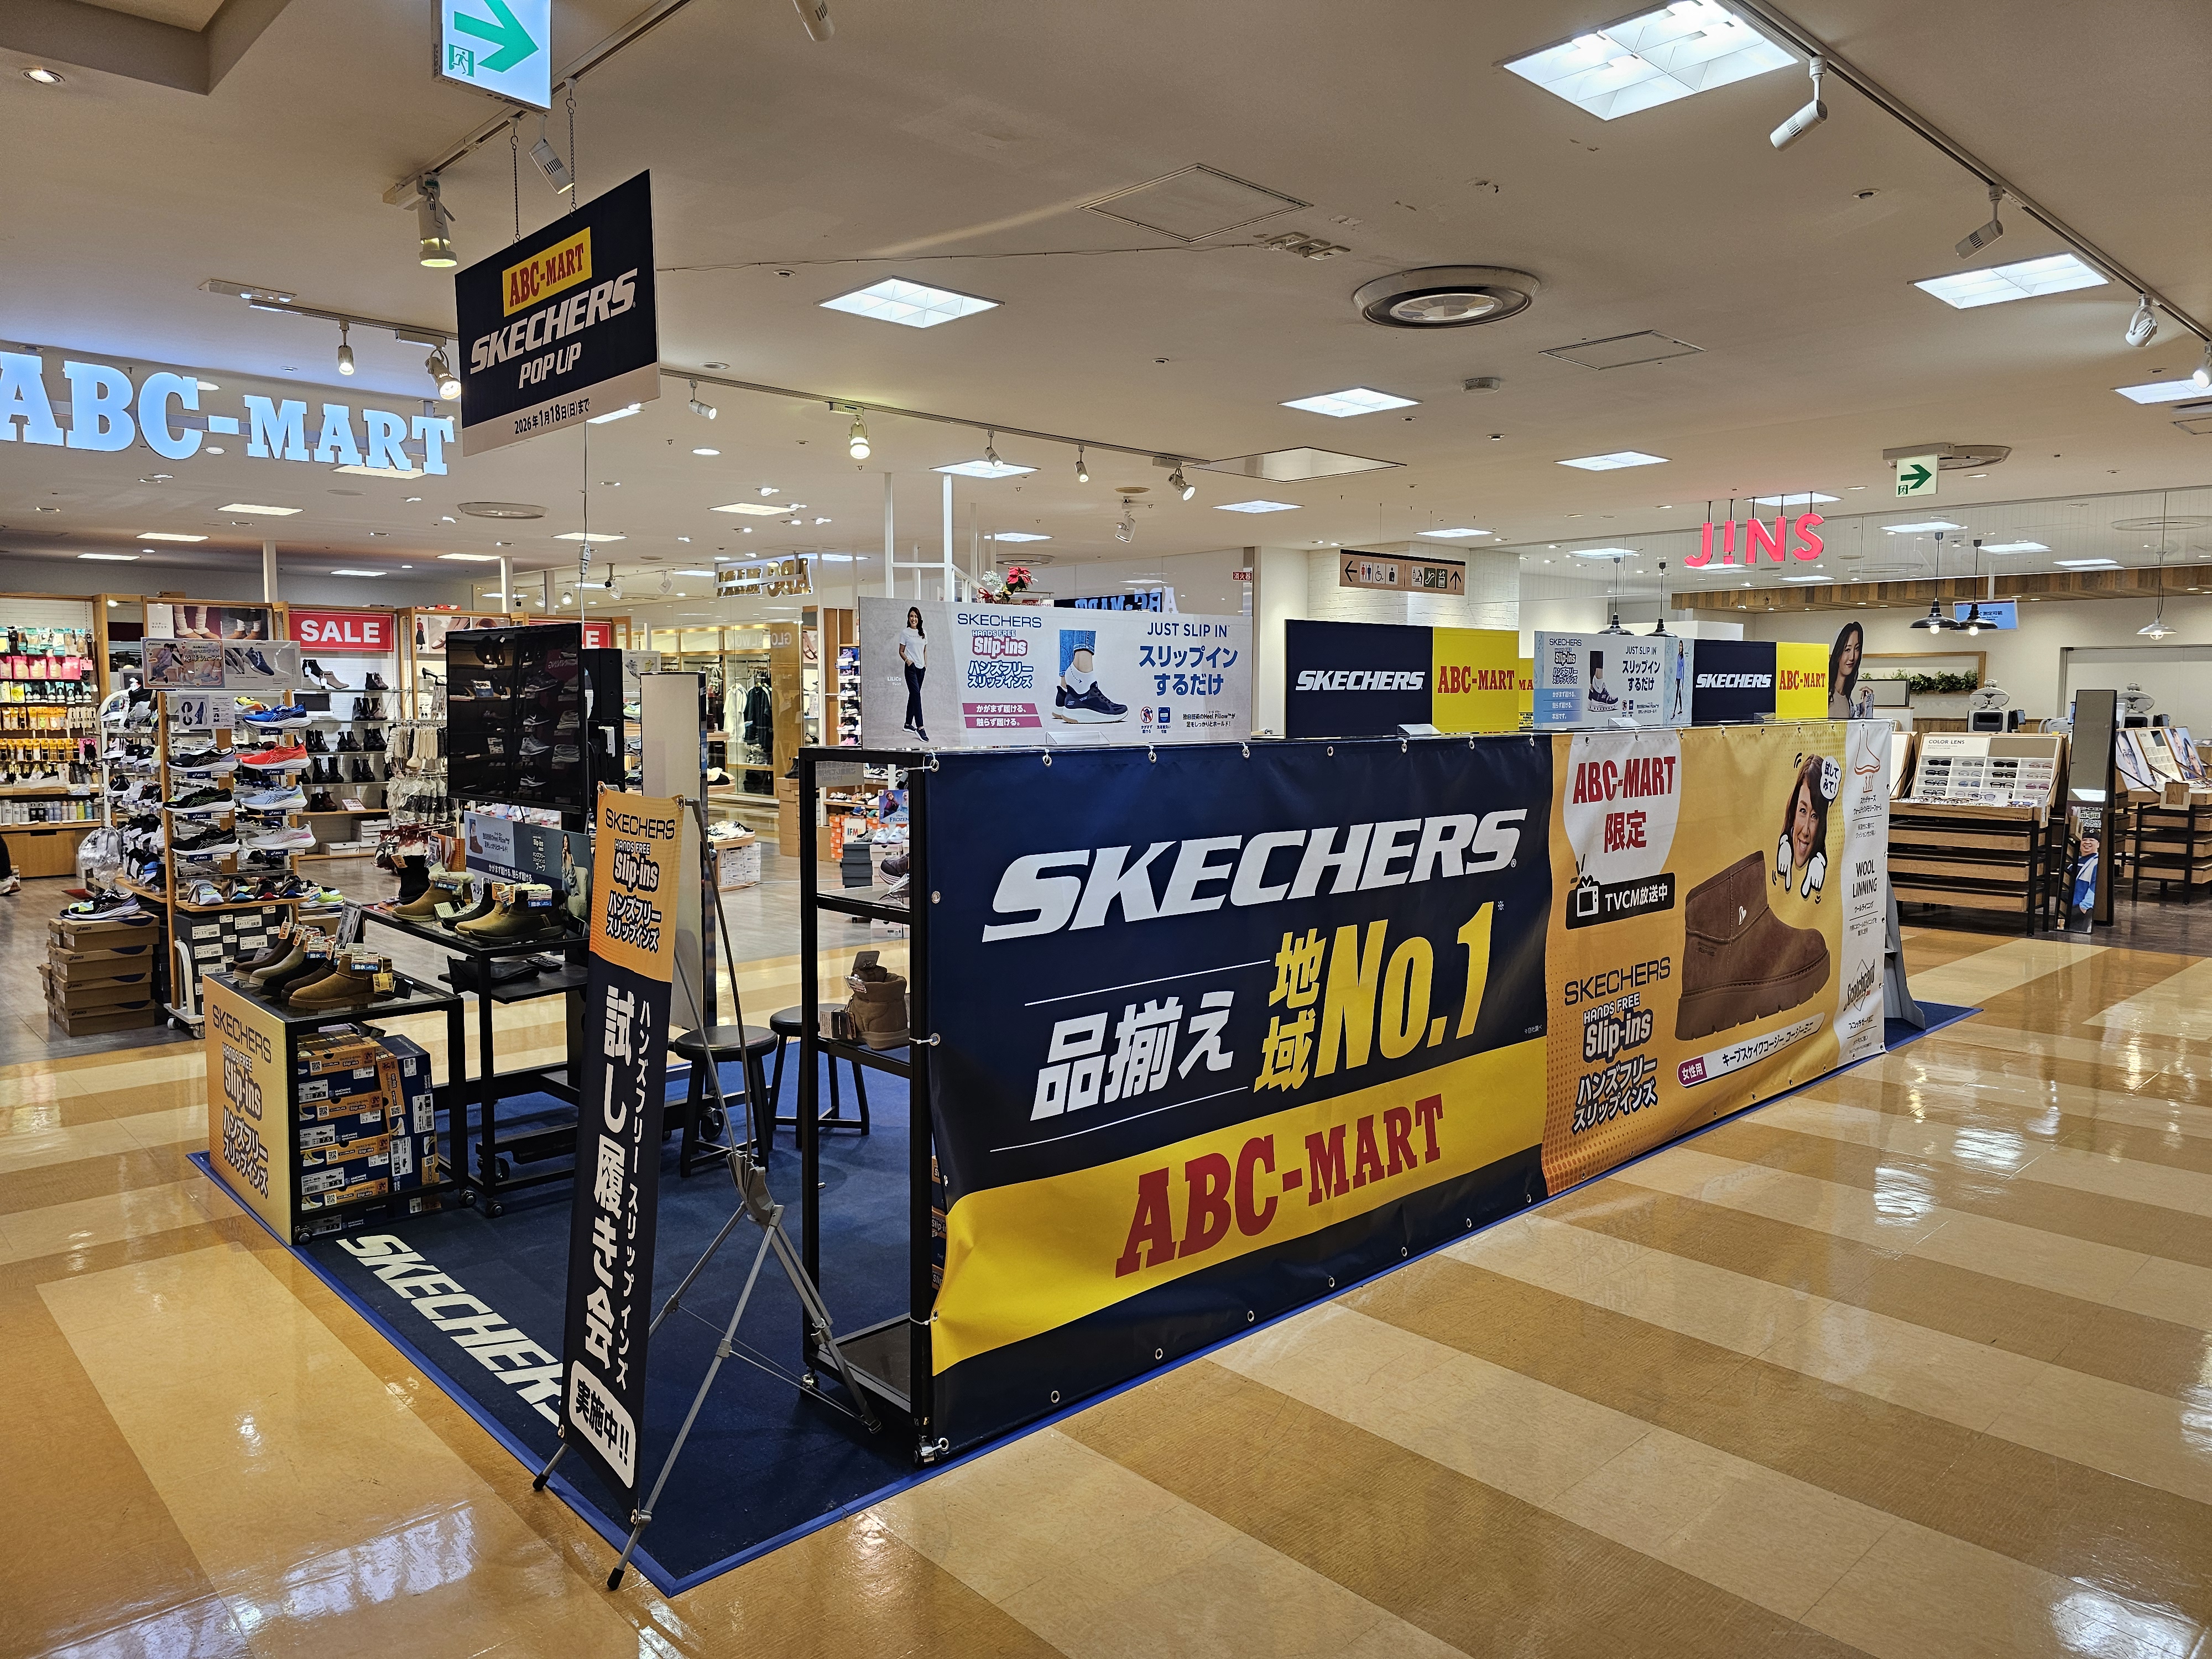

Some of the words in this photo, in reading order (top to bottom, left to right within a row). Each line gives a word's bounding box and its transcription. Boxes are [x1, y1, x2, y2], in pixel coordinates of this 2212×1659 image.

[509, 243, 585, 307] ABC-MART
[519, 353, 555, 389] POP
[556, 342, 582, 375] UP
[0, 352, 455, 476] ABC-MART
[515, 398, 590, 435] 2026年1月18日(日)まで
[300, 620, 380, 643] SALE
[958, 613, 1041, 628] SKECHERS
[1147, 623, 1180, 637] JUST
[1183, 623, 1211, 638] SLIP
[973, 637, 1027, 658] Slip-ins
[1139, 645, 1238, 669] スリップイン
[1555, 653, 1576, 665] Slip-ins
[1626, 646, 1638, 654] JUST
[1640, 646, 1650, 655] SLIP
[968, 660, 1034, 675] ハンズフリー
[968, 675, 1032, 688] スリップインズ
[1295, 670, 1425, 691] SKECHERS
[1438, 666, 1515, 693] ABC-MART
[1553, 667, 1578, 676] ハンズフリー
[1622, 660, 1660, 674] スリップイン
[1695, 673, 1771, 688] SKECHERS
[1779, 669, 1825, 691] ABC-MART
[1155, 673, 1224, 696] するだけ
[1628, 677, 1655, 691] するだけ
[976, 705, 1026, 713] かがまず履ける、
[976, 718, 1020, 726] 触らず履ける。
[1573, 756, 1676, 804] ABC-MART
[606, 807, 675, 840] SKECHERS
[1604, 810, 1647, 853] 限定
[614, 839, 635, 853] HANDS
[635, 842, 651, 855] FREE
[535, 863, 545, 872] ブーツ
[615, 851, 659, 889] Slip-ins
[1856, 859, 1875, 877] WOOL
[1605, 883, 1667, 912] TVCM放送中
[1853, 878, 1877, 898] LINNING
[608, 892, 662, 928] ハンズフリー
[606, 916, 660, 953] スリップインズ
[1564, 957, 1671, 1005] SKECHERS
[1030, 991, 1234, 1121] 品揃え
[1253, 928, 1326, 1093] 地域
[1314, 901, 1494, 1078] No.1
[1583, 999, 1615, 1024] HANDS
[1616, 992, 1640, 1014] FREE
[213, 1005, 272, 1064] SKECHERS
[1585, 1010, 1652, 1061] Slip-ins
[222, 1042, 239, 1063] HANDS
[239, 1052, 253, 1073] FREE
[1682, 1063, 1704, 1081] 女性用
[225, 1066, 262, 1118] Slip-ins
[633, 999, 650, 1174] ハンズフリー
[1577, 1055, 1657, 1105] ハンズフリー
[1573, 1080, 1657, 1134] スリップインズ
[223, 1107, 269, 1163] ハンズフリー
[223, 1139, 269, 1199] スリップインズ
[1115, 1093, 1443, 1279] ABC-MART
[616, 1183, 638, 1391] スリップインズ
[575, 1380, 629, 1467] 実施中!!
